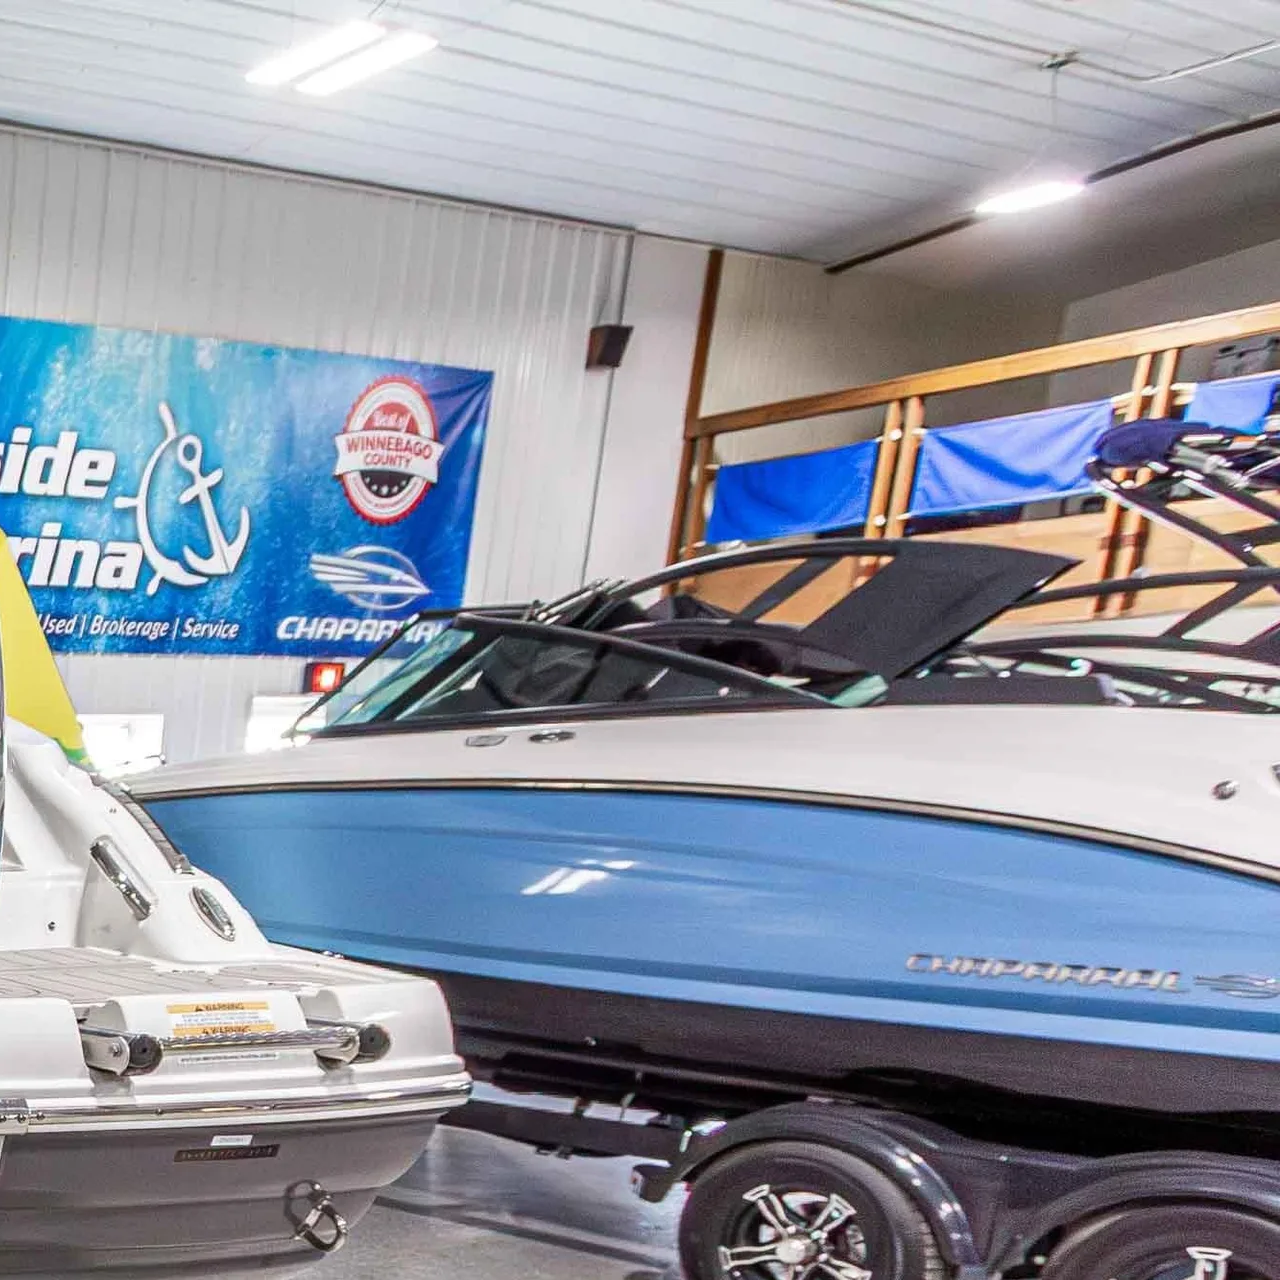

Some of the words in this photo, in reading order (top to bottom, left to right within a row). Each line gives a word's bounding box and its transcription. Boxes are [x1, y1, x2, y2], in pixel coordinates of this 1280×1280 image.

[346, 436, 433, 460] WINNEBAGO
[364, 452, 412, 468] COUNTY
[90, 614, 171, 640] Brokerage
[182, 617, 241, 639] Service
[904, 953, 1190, 992] CHAPARRAL
